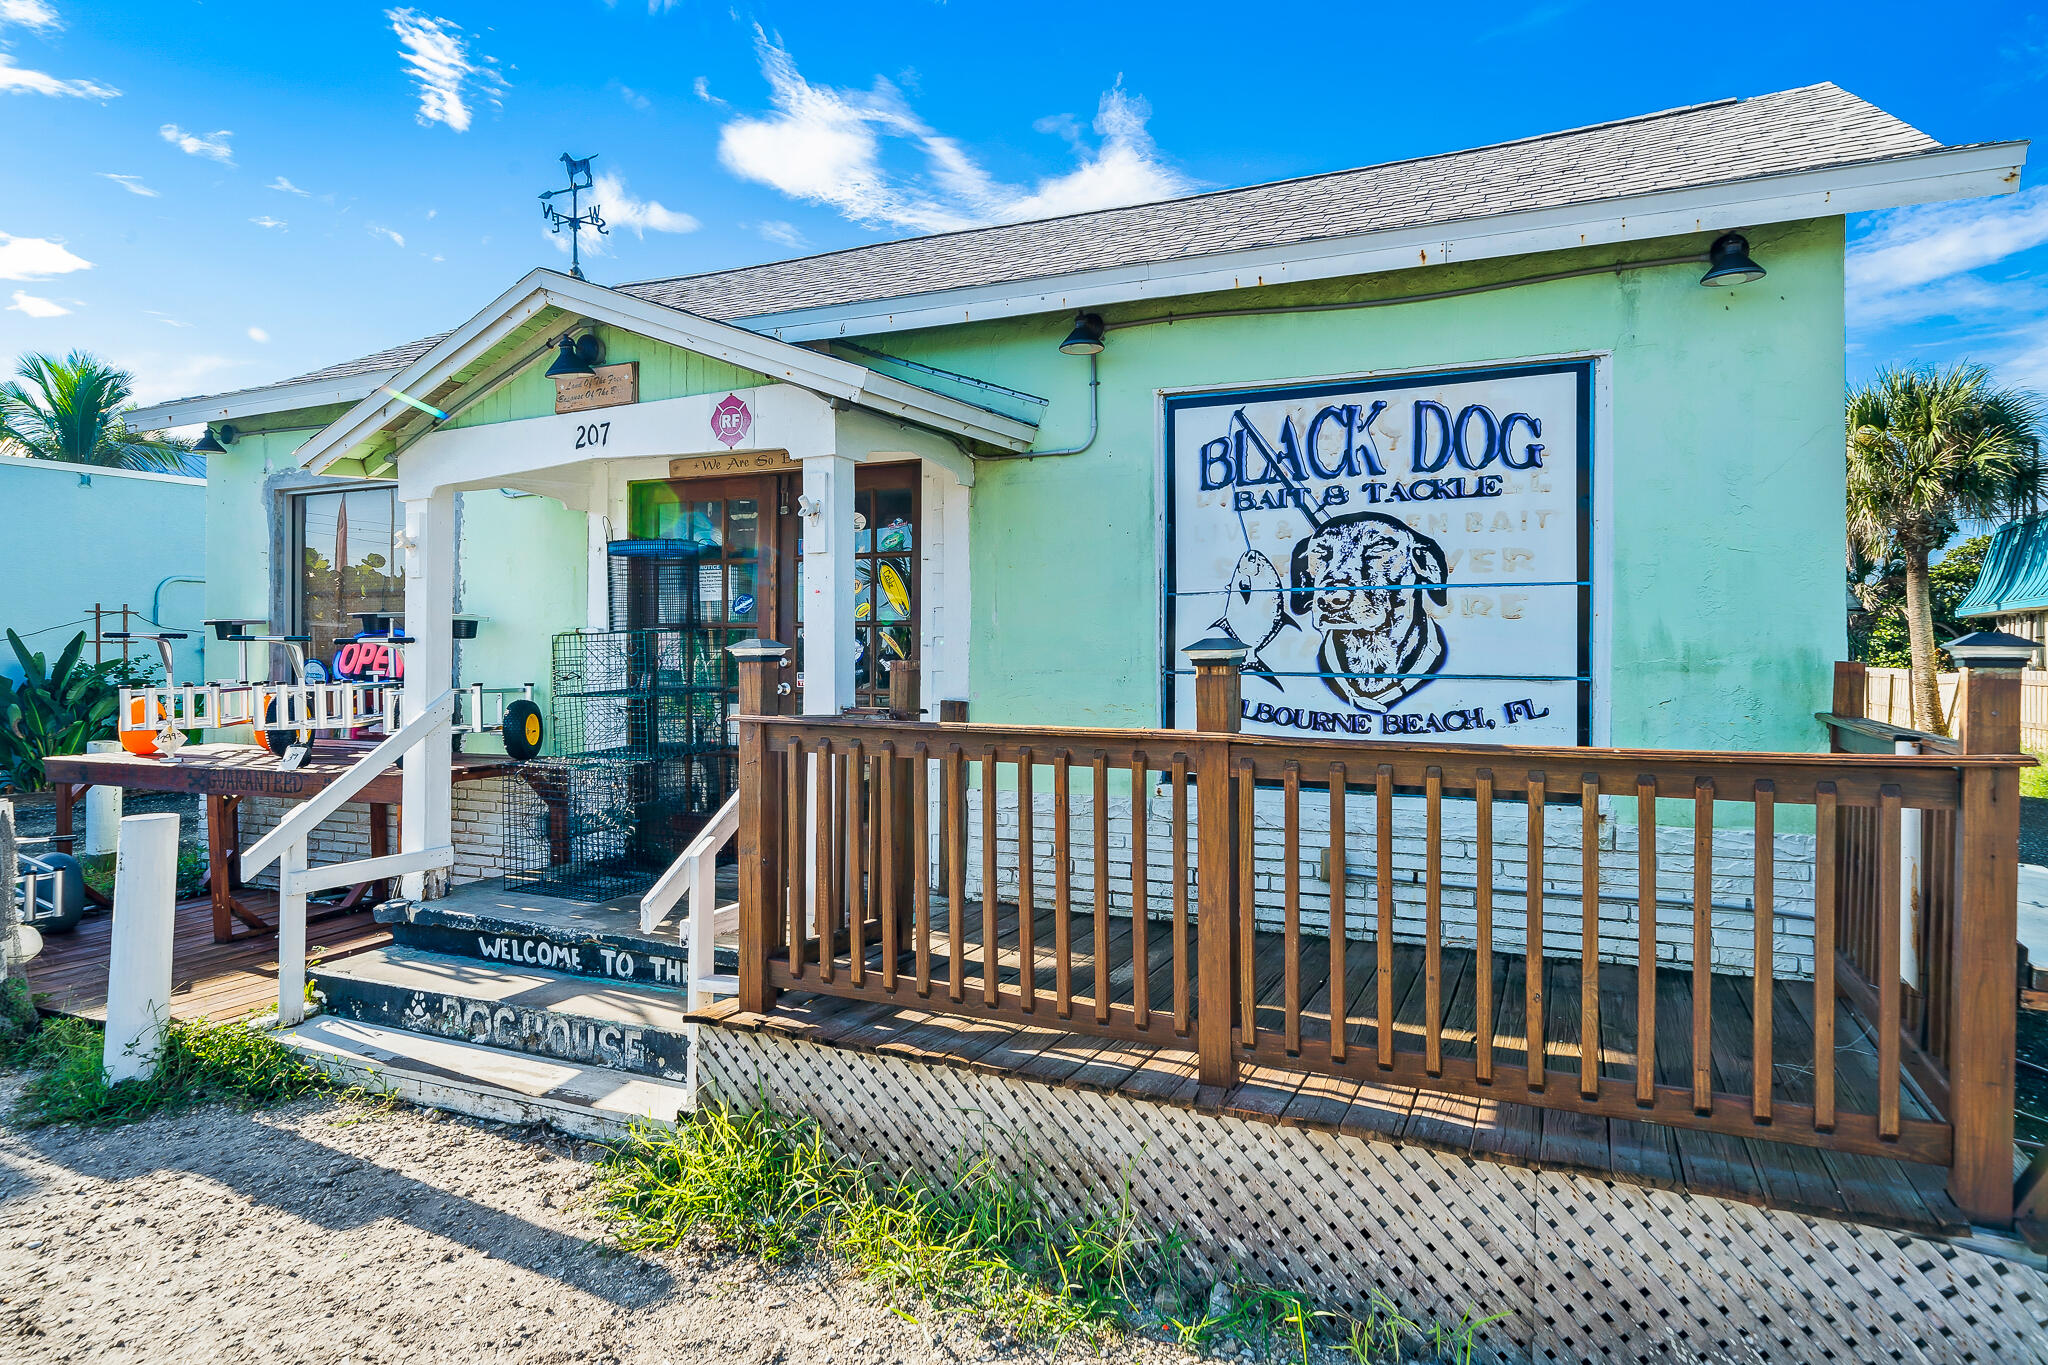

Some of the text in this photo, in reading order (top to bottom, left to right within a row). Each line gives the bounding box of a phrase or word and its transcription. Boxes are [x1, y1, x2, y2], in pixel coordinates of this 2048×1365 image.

[575, 421, 611, 449] 207
[722, 413, 740, 428] RF
[701, 459, 721, 471] We
[727, 457, 750, 470] Are
[756, 454, 774, 467] So
[1200, 400, 1545, 491] BLACK DOG
[1234, 486, 1311, 512] BAIT
[1324, 485, 1350, 507] &
[1361, 474, 1503, 504] TACKLE
[1241, 698, 1550, 735] LBOURNE BEACH, FL
[478, 936, 583, 971] WELCOME
[600, 949, 634, 978] TO
